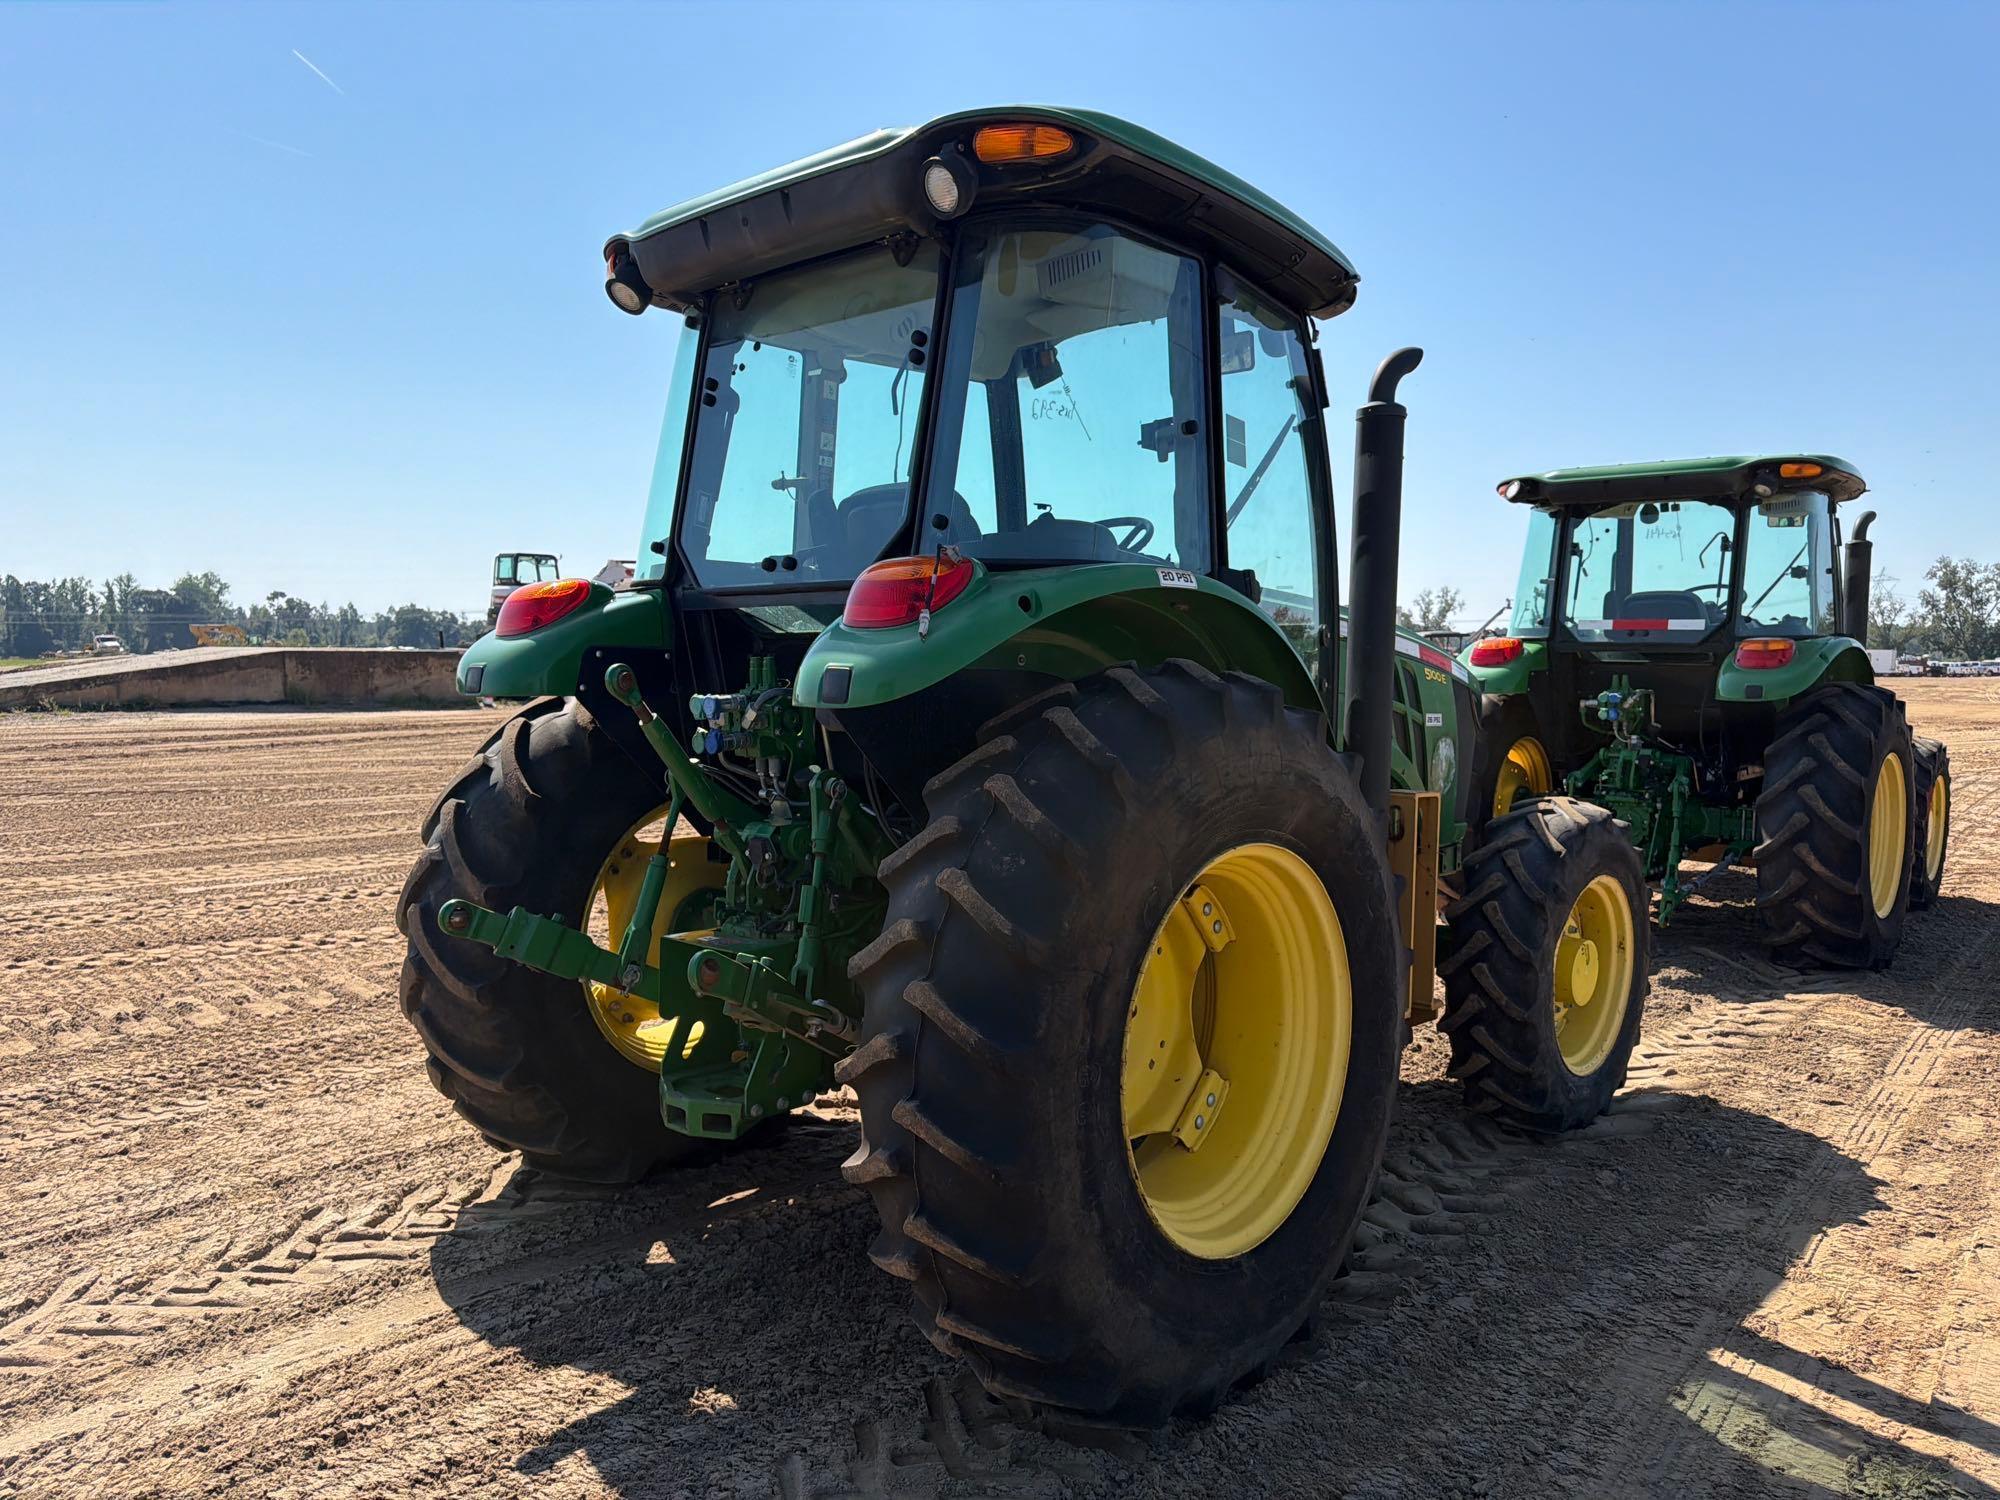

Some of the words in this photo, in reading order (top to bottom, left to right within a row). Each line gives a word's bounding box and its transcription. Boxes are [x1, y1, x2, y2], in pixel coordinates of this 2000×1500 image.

[1160, 570, 1175, 582] 20
[1175, 571, 1194, 584] PSI
[1423, 667, 1447, 685] 5100E
